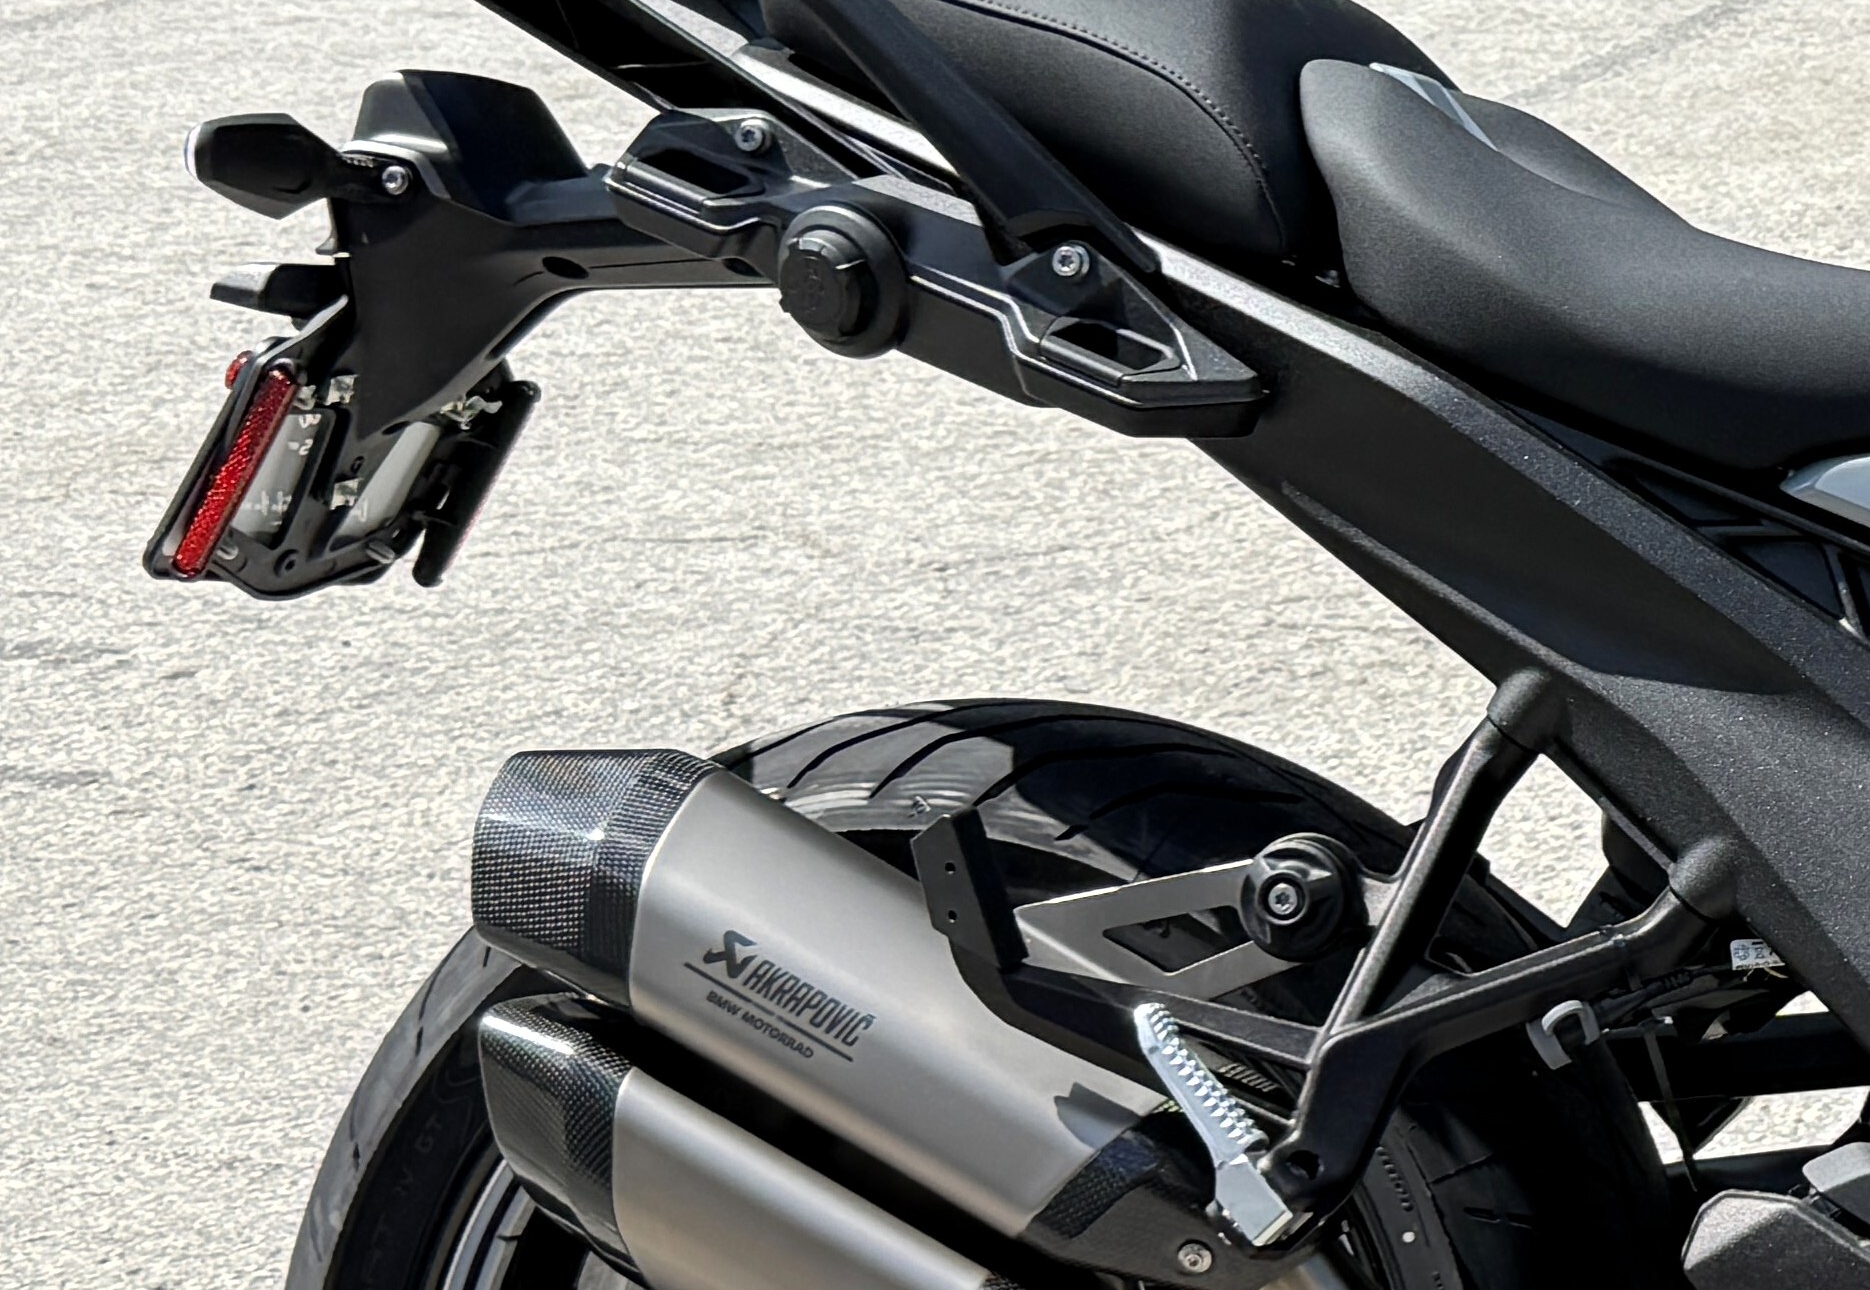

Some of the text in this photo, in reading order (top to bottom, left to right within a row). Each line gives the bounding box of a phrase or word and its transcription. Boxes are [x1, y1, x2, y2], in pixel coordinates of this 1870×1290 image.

[706, 990, 815, 1060] BMW MOTORRAD
[741, 959, 877, 1047] AKRAPOVIČ
